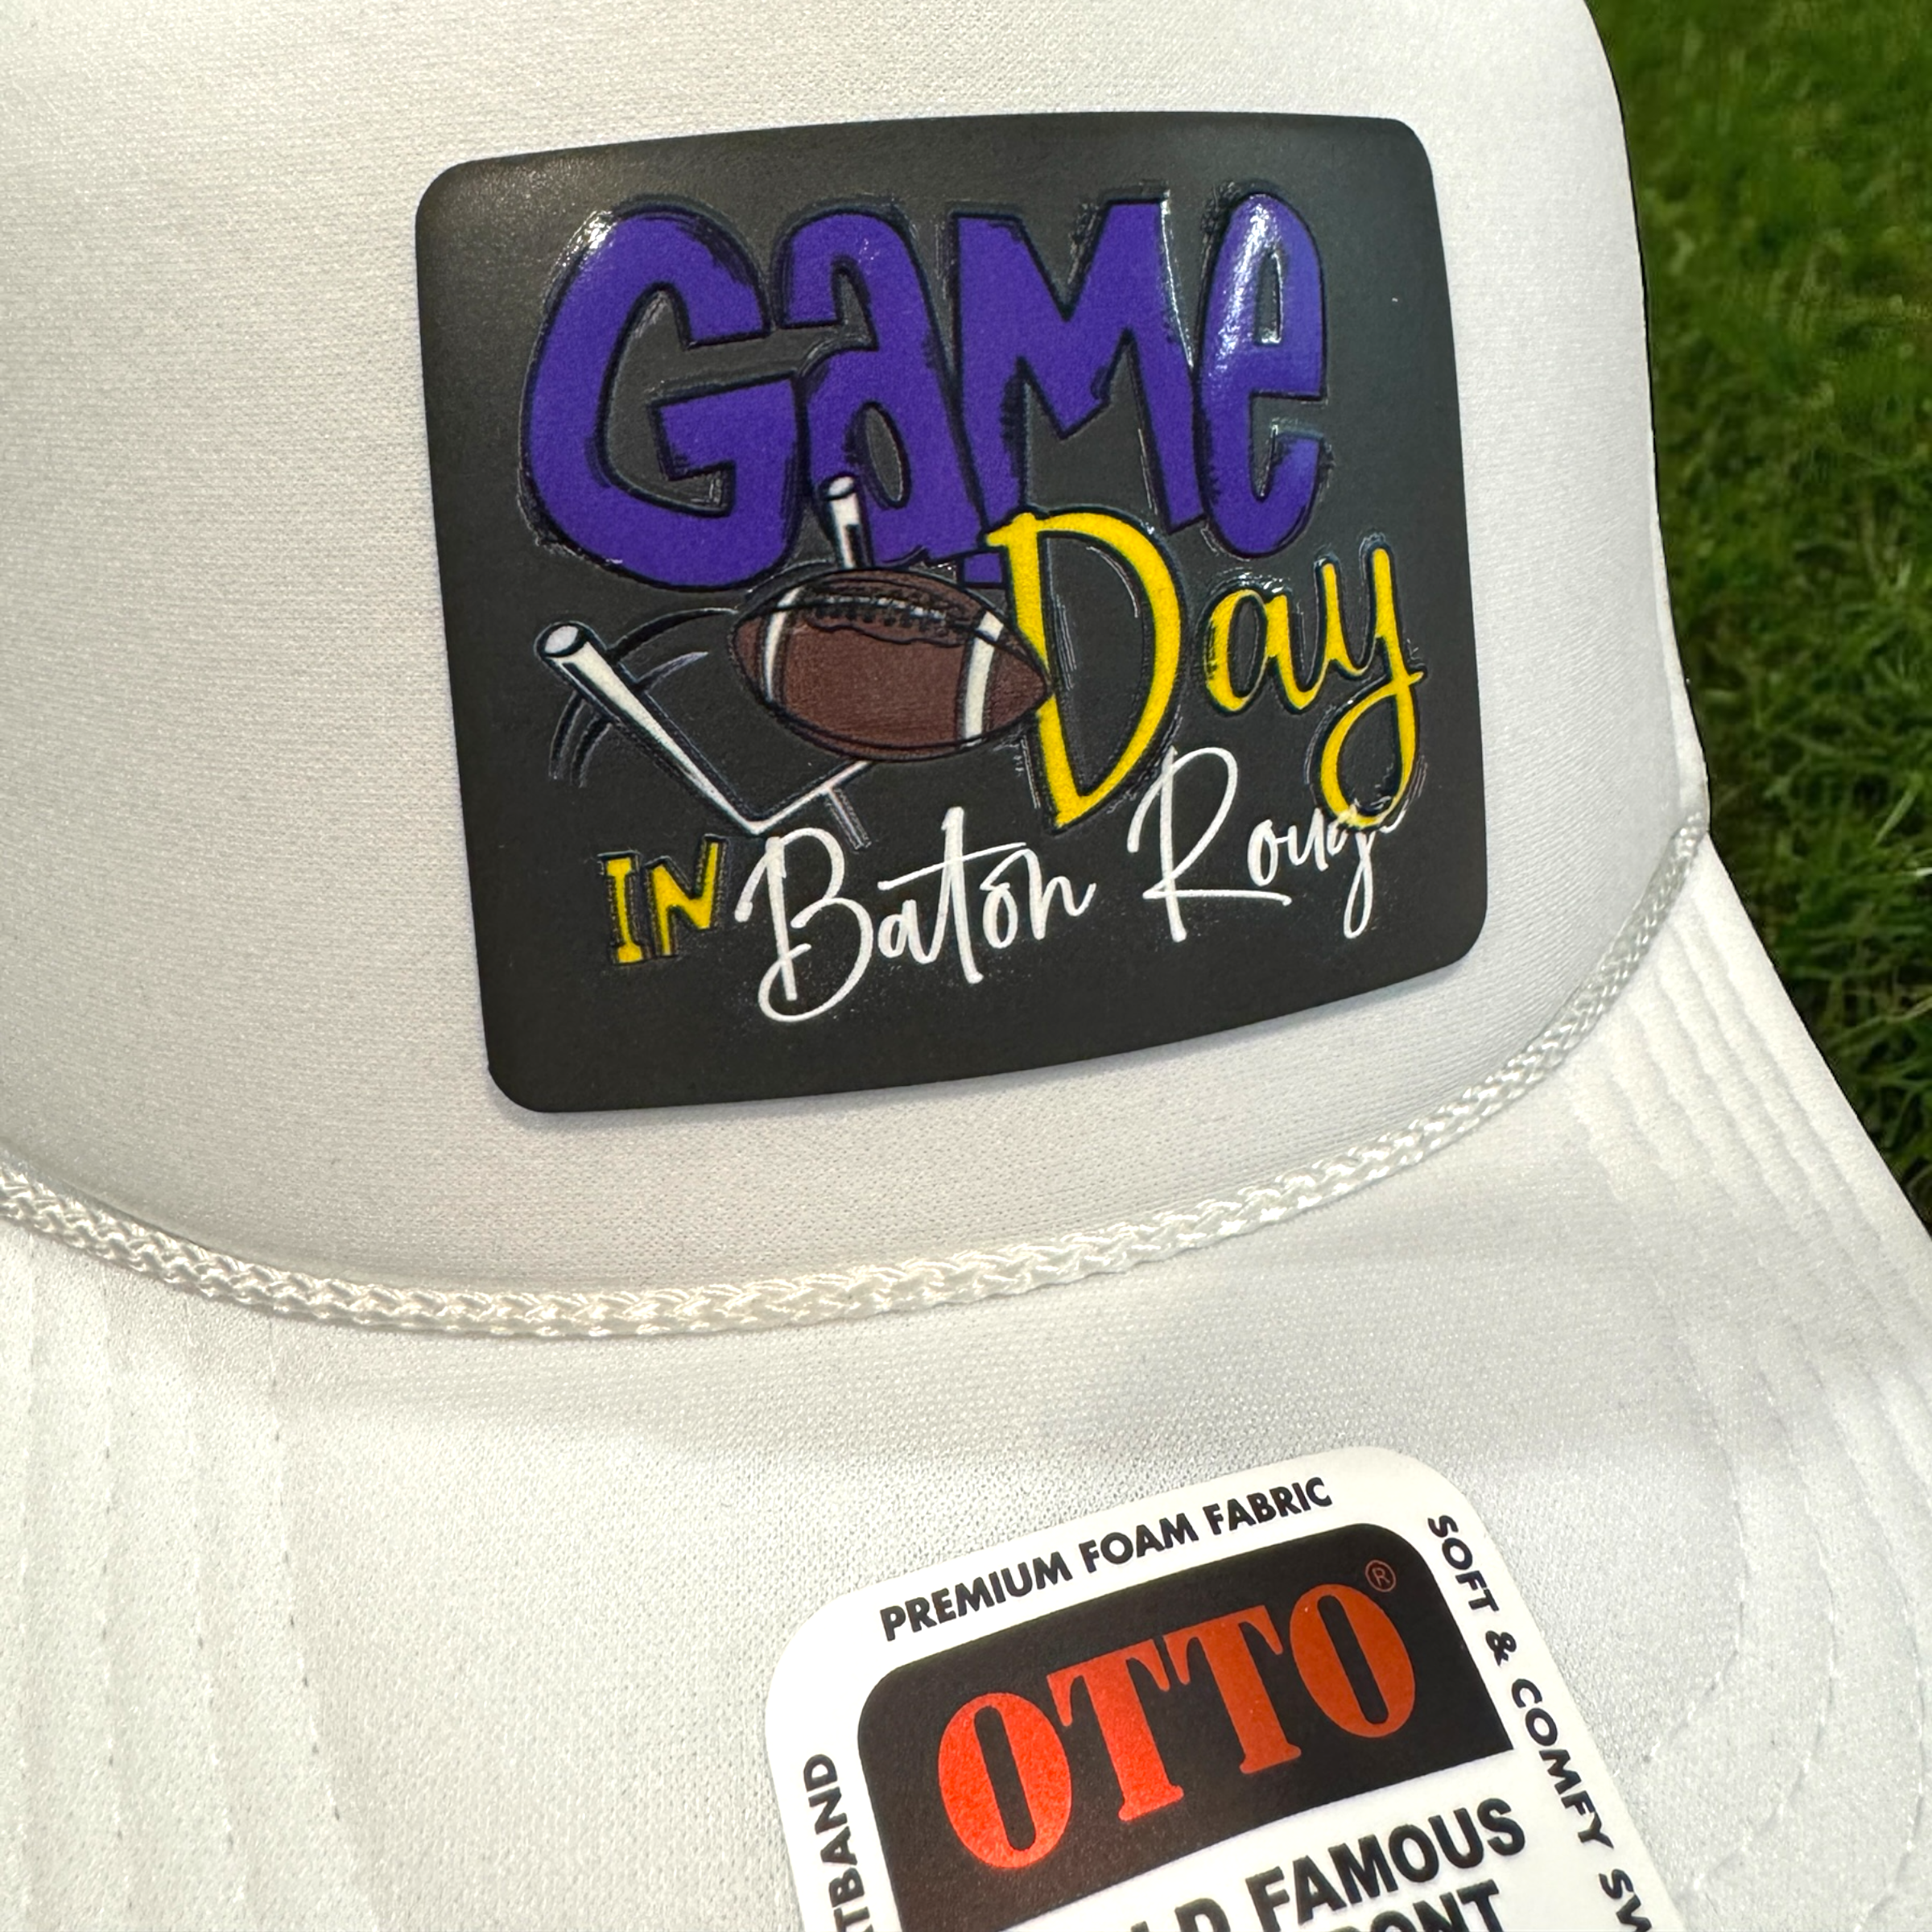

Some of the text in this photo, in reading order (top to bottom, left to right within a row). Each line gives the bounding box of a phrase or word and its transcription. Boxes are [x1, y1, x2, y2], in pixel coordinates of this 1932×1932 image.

[984, 509, 1427, 829] Day
[601, 836, 724, 964] IN
[733, 806, 1096, 1022] Baton
[880, 1476, 1332, 1641] PREMIUM FOAM FABRIC
[937, 1583, 1415, 1871] OTTO
[1427, 1515, 1500, 1612] SOFT
[1485, 1630, 1517, 1666] &
[1511, 1678, 1614, 1849] COMFY
[803, 1754, 874, 1932] TBAND
[1245, 1798, 1525, 1932] FAMOUS
